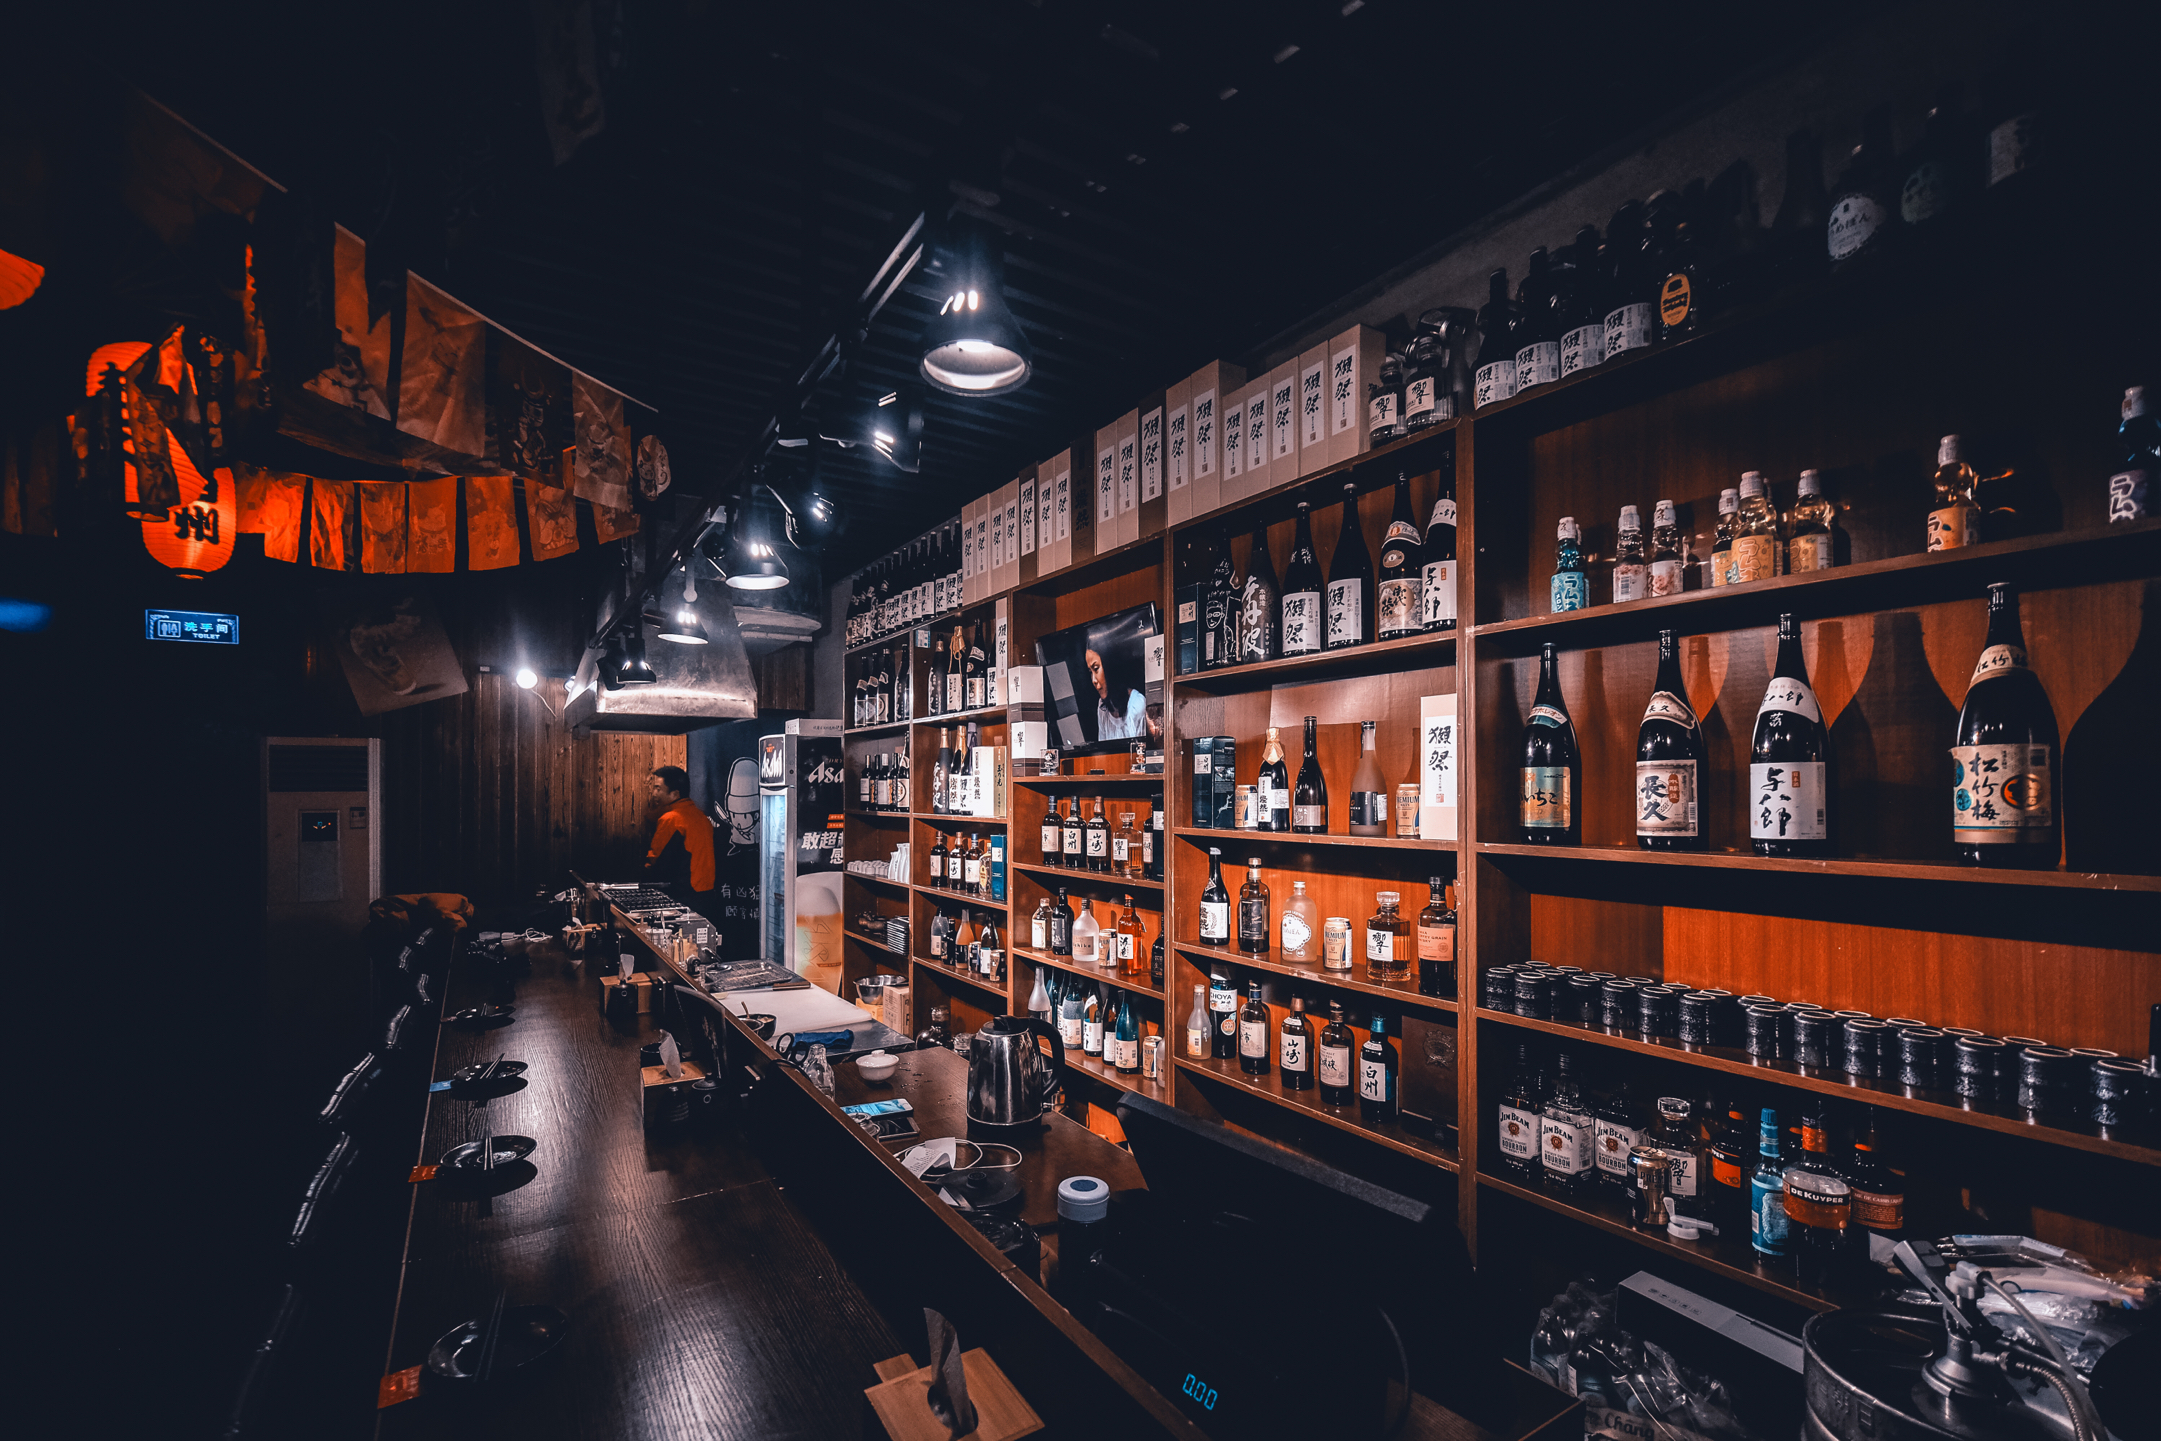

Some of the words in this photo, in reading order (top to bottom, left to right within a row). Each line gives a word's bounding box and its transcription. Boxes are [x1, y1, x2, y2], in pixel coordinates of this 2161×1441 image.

[175, 506, 220, 545] 州
[184, 621, 228, 634] 洗手间
[192, 632, 220, 640] TOILET
[1428, 725, 1452, 772] 獺祭
[1969, 752, 2000, 821] 松竹梅
[1641, 775, 1670, 821] 長久
[1759, 766, 1791, 836] 与八郎
[1068, 830, 1077, 849] 白州
[1092, 832, 1103, 852] 山崎
[1372, 932, 1389, 953] 響
[1286, 1039, 1300, 1064] 山崎
[1365, 1066, 1378, 1096] 白州
[1500, 1111, 1511, 1122] JIM
[1511, 1112, 1530, 1129] BEAM
[1543, 1124, 1554, 1135] JIM
[1554, 1125, 1573, 1143] BEAM
[1597, 1126, 1609, 1136] JIM
[1609, 1127, 1629, 1145] BEAM
[1502, 1139, 1527, 1153] BOURBON
[1544, 1153, 1571, 1167] BOURBON
[1598, 1155, 1626, 1170] BOURBON
[1182, 1372, 1218, 1410] 0.00
[1604, 1412, 1655, 1441] Chang
